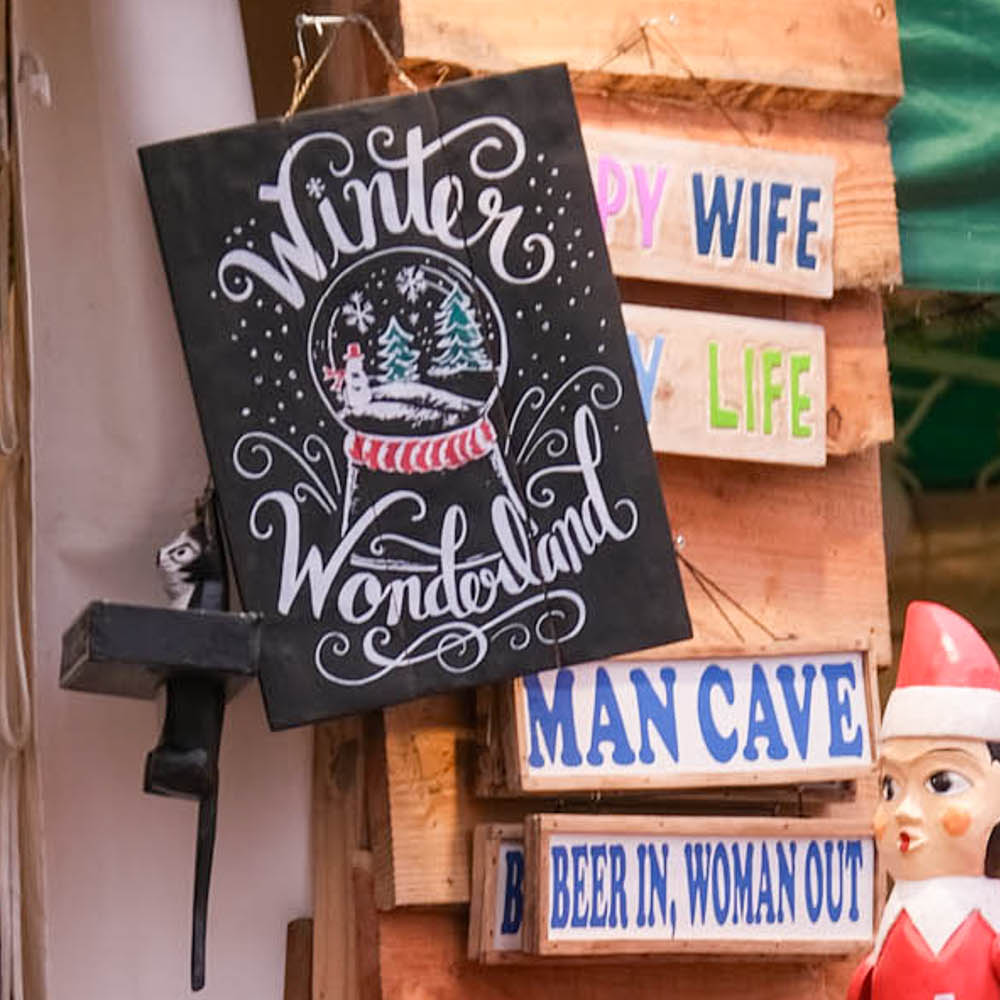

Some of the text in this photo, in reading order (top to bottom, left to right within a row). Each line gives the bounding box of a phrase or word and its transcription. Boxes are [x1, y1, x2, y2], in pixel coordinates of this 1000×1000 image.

[219, 116, 554, 309] Winter
[692, 173, 821, 270] WIFE
[709, 342, 811, 438] LIFE
[250, 405, 637, 625] Wonderland
[523, 662, 863, 767] MAN CAVE
[550, 839, 864, 939] BEER IN, WOMAN OUT
